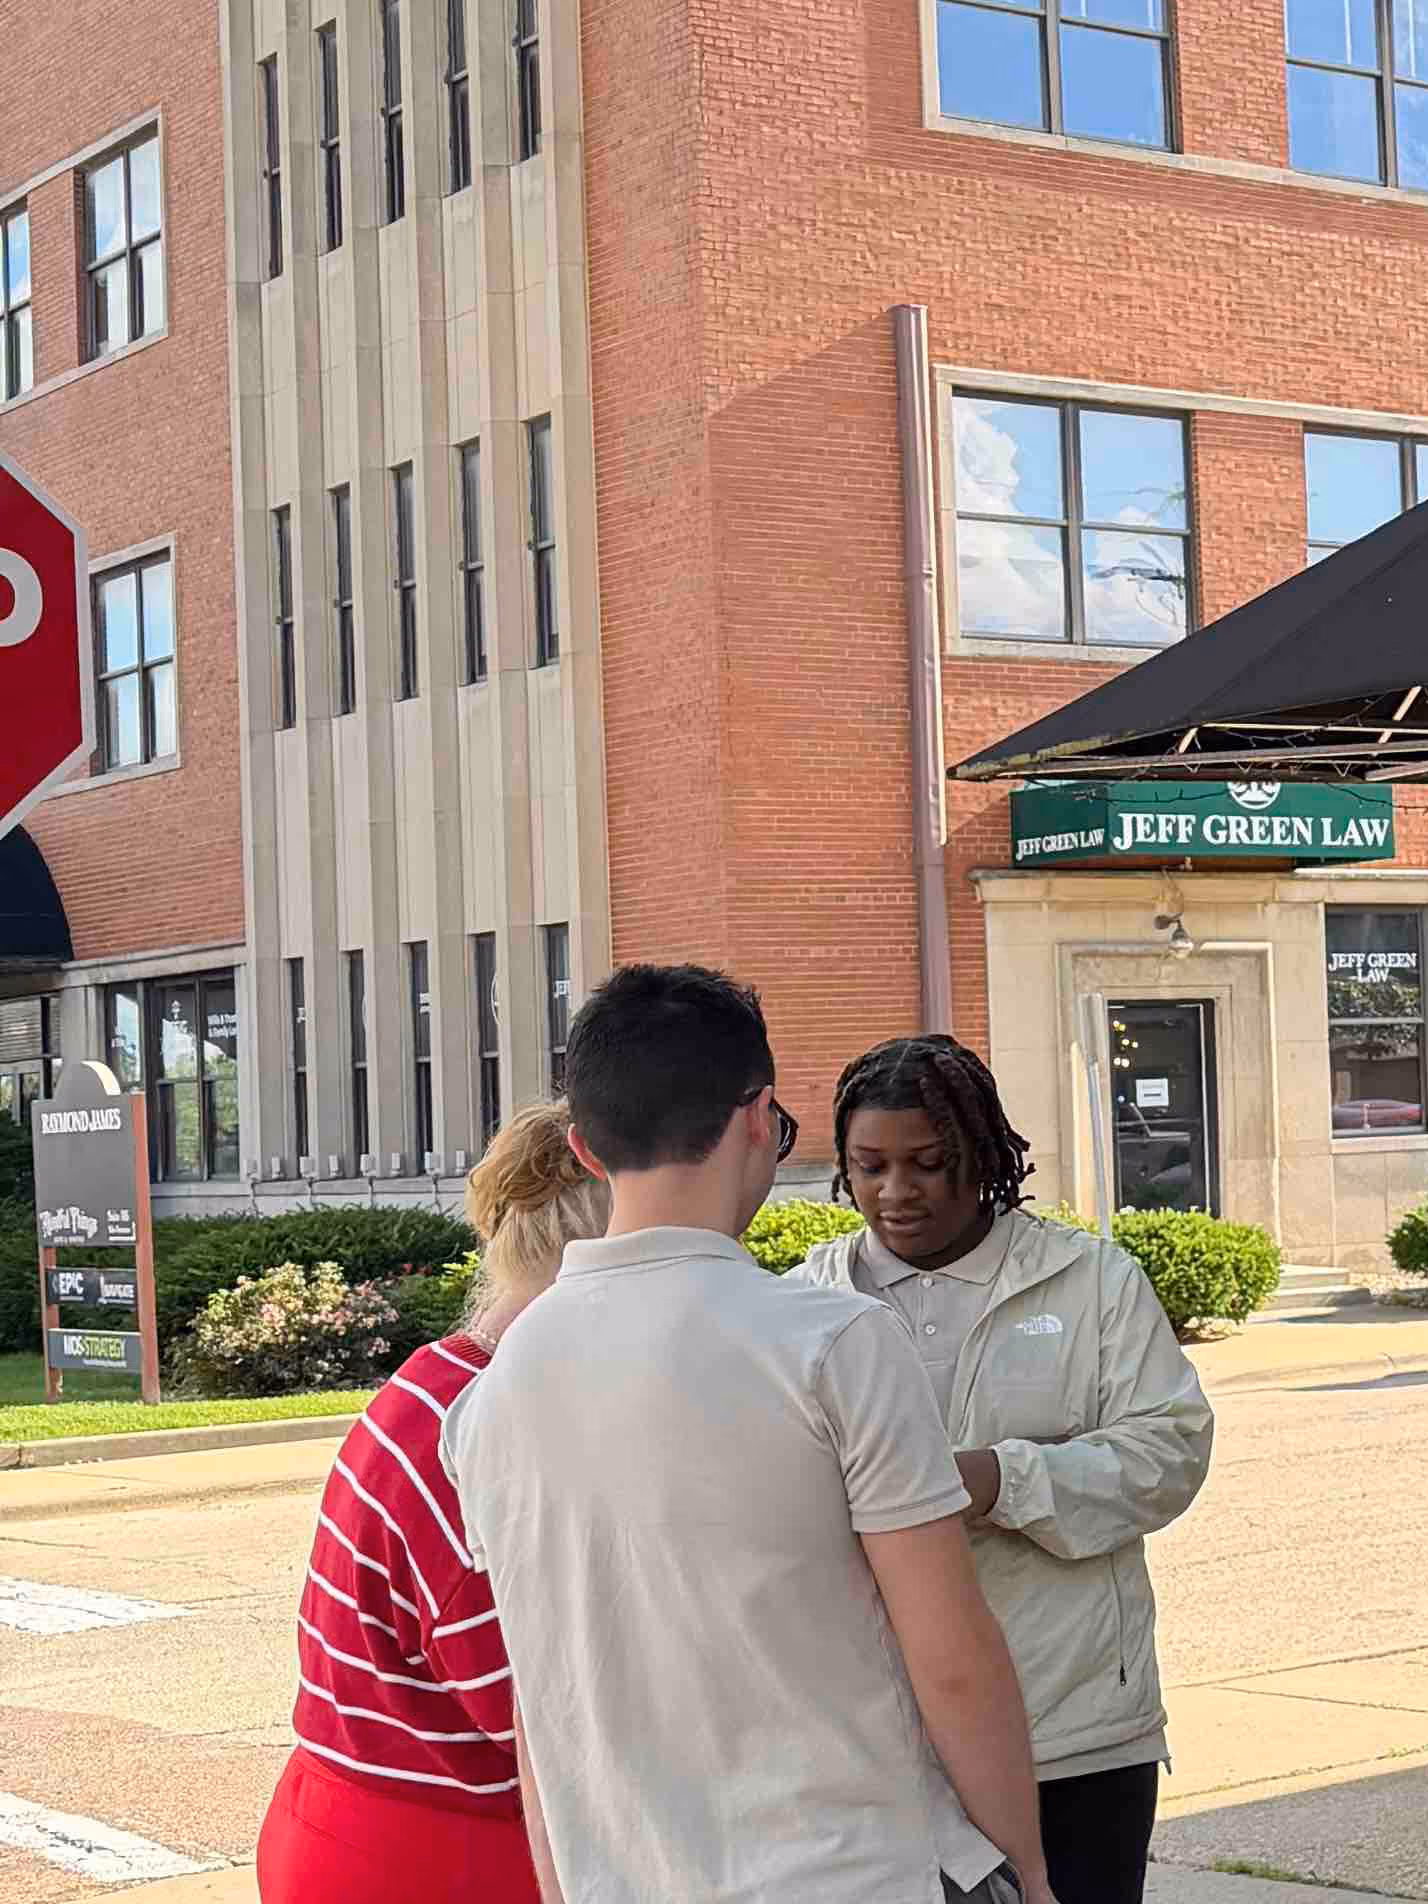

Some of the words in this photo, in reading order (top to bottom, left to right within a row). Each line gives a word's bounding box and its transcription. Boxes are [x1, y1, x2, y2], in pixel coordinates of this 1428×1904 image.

[1016, 837, 1041, 860] JEFF
[1042, 832, 1078, 854] GREEN
[1079, 828, 1105, 847] LAW
[1112, 813, 1197, 850] JEFF
[1202, 813, 1313, 847] GREEN
[1321, 817, 1391, 847] LAW
[1328, 953, 1365, 971] JEFF
[1367, 953, 1417, 968] GREEN
[1357, 968, 1389, 983] LAW
[41, 1110, 88, 1134] RAYMOND
[89, 1108, 121, 1131] JAMES
